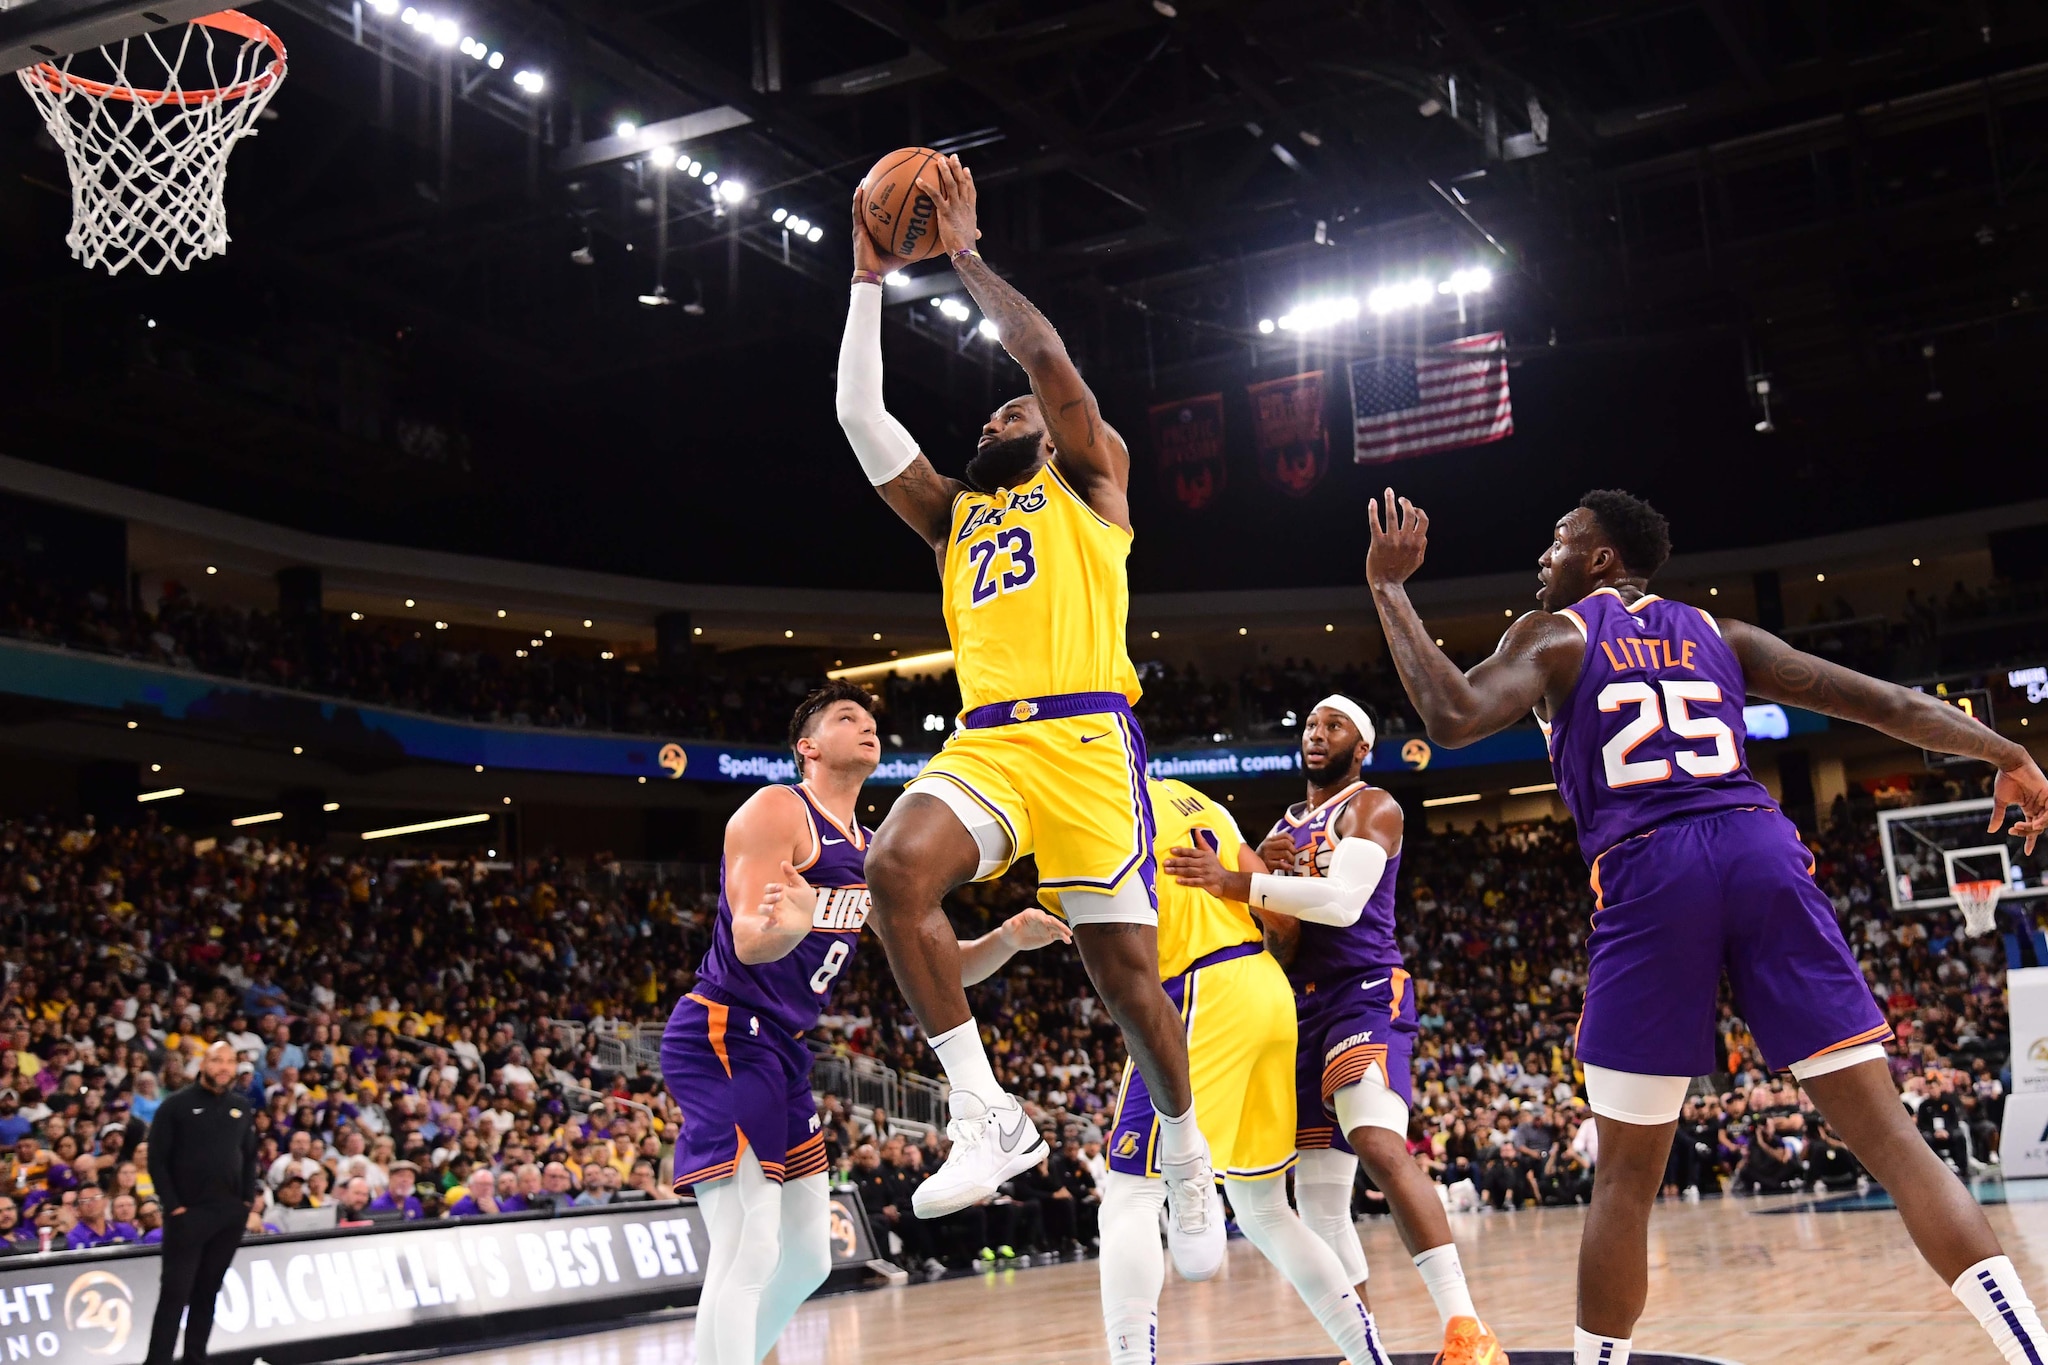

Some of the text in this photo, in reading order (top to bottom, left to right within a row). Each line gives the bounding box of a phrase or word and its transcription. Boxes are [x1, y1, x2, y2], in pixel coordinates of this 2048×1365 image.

[898, 194, 933, 255] Wilson
[956, 485, 1047, 545] LAKRS
[970, 527, 1037, 604] 23
[1601, 637, 1697, 672] LITTLE
[1598, 680, 1740, 788] 25
[718, 753, 796, 781] Spotlight
[1146, 753, 1238, 777] rtainment
[1241, 754, 1297, 772] come
[1170, 796, 1205, 817] DAVI
[813, 887, 872, 929] UNS
[810, 940, 849, 995] 8
[0, 1283, 54, 1326] HT
[213, 1218, 699, 1334] OACHELLA'S BEST BET
[73, 1280, 133, 1355] 29
